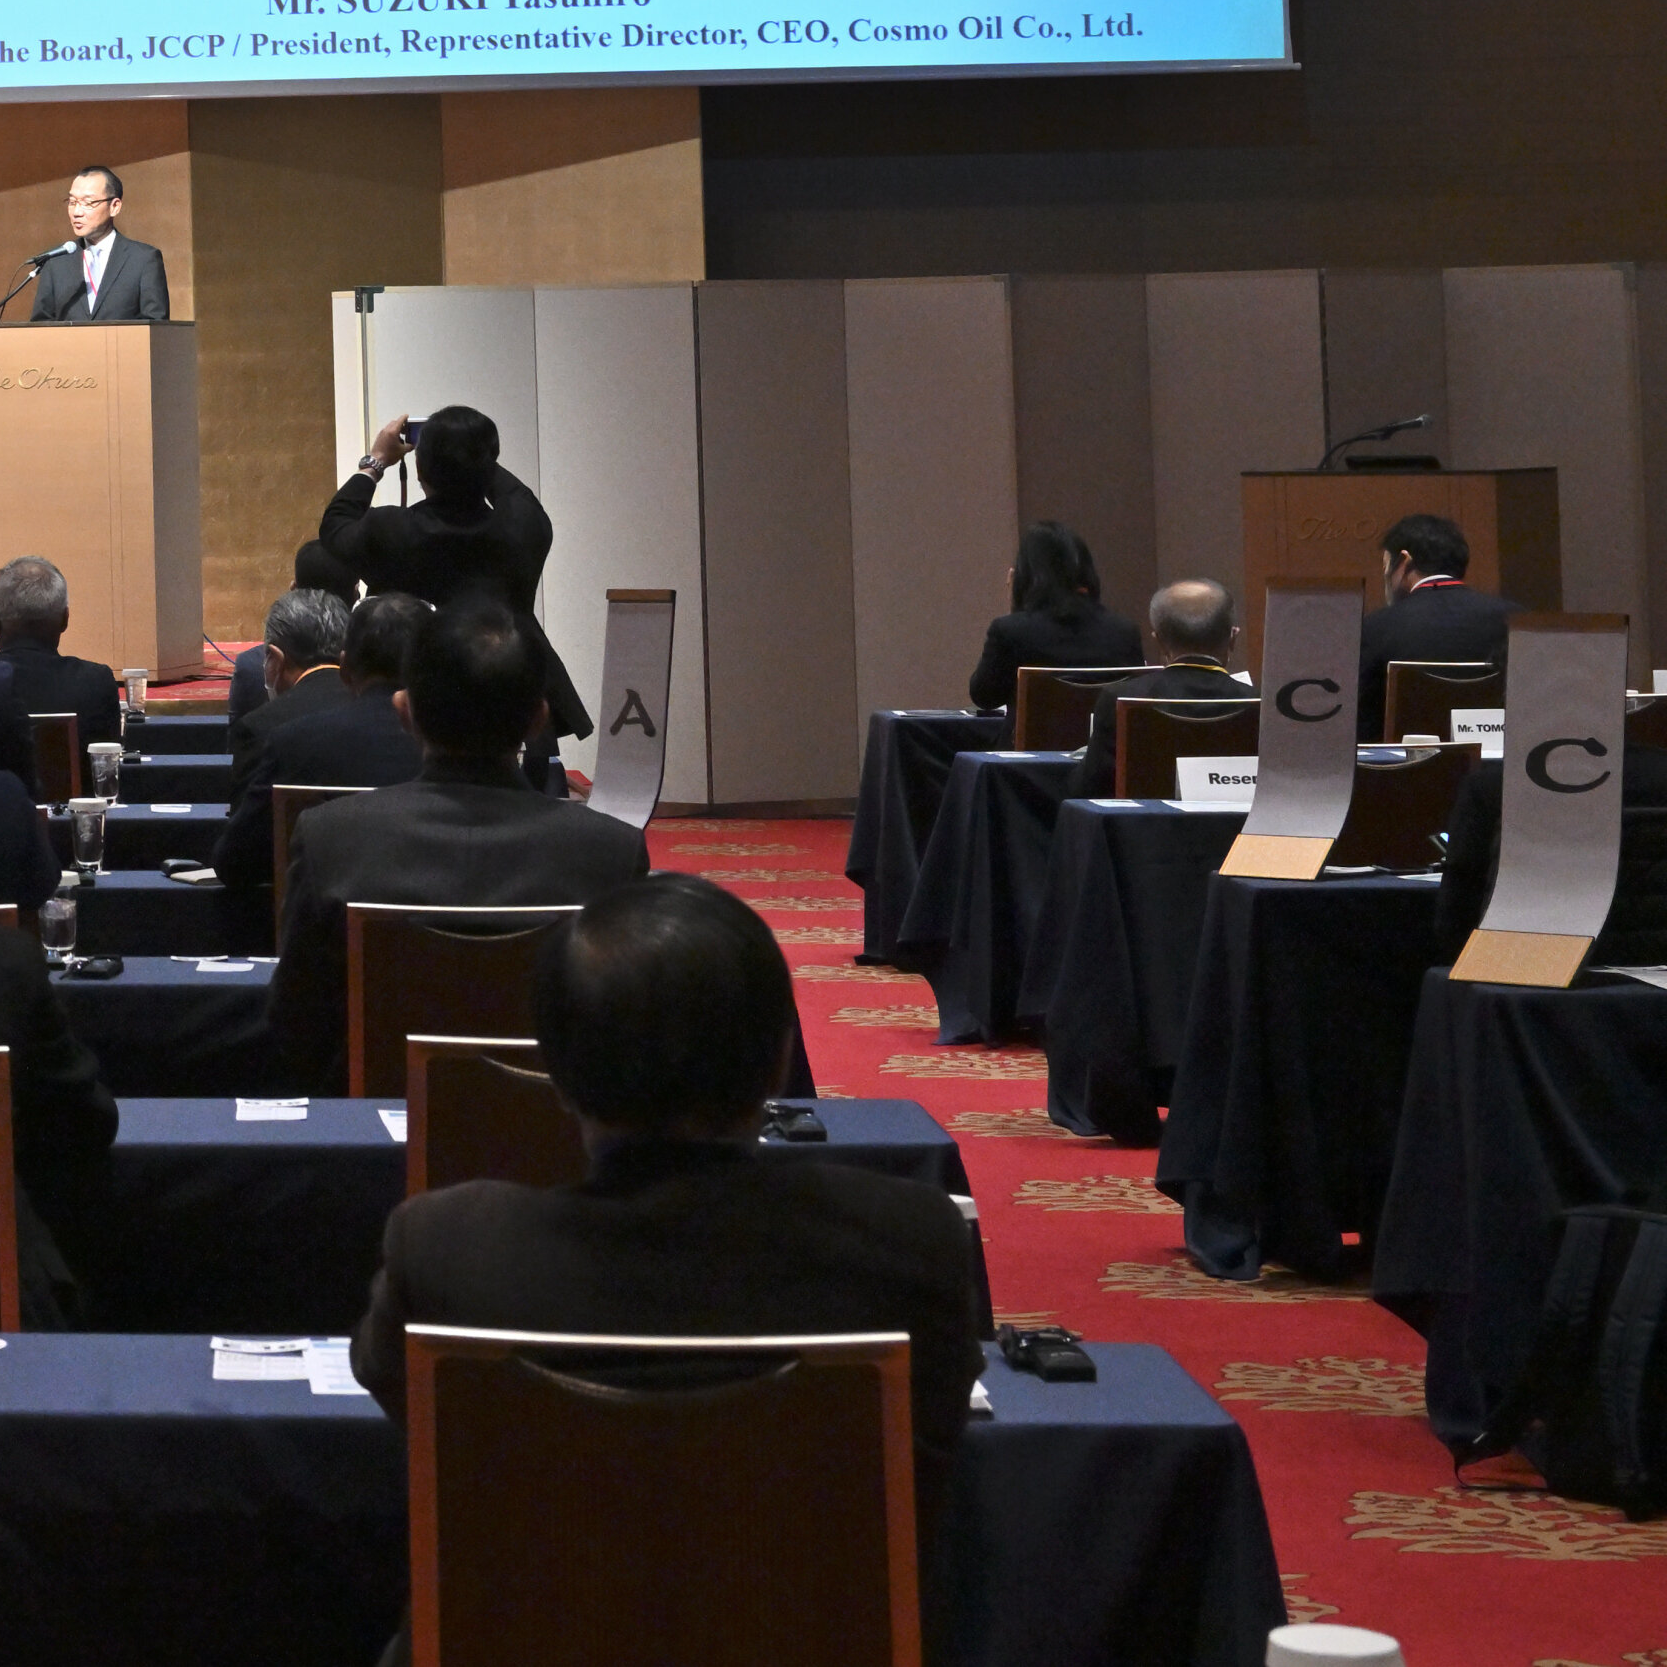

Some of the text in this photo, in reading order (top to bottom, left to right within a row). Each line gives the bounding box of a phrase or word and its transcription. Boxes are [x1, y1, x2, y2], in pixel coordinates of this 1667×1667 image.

[39, 37, 133, 64] Board,
[142, 35, 225, 59] JCCP
[250, 31, 391, 58] President,
[399, 25, 612, 58] Representative
[621, 24, 747, 50] Director,
[757, 20, 839, 48] CEO,
[848, 18, 948, 42] Cosmo
[958, 16, 1003, 40] Oil
[1013, 15, 1072, 43] Co.,
[1081, 13, 1143, 37] Ltd.
[19, 366, 98, 390] Okura
[610, 689, 656, 737] A
[1276, 678, 1343, 722] C
[1457, 724, 1475, 733] Mr.
[1525, 737, 1611, 794] C
